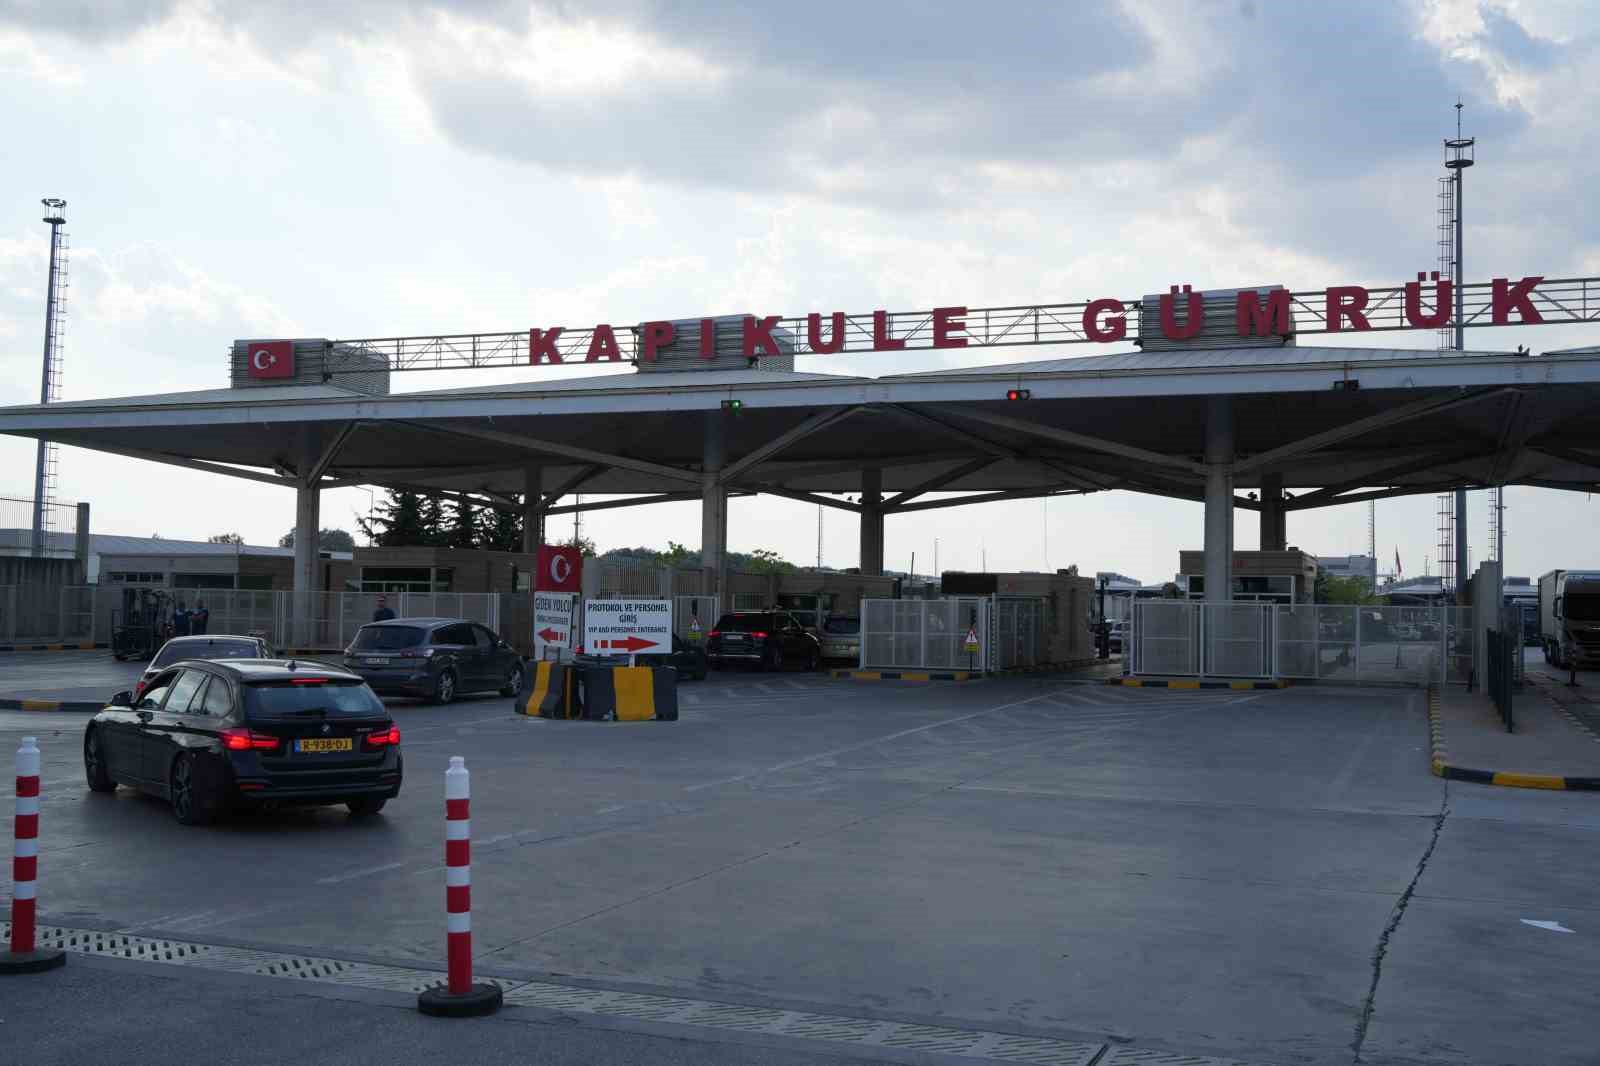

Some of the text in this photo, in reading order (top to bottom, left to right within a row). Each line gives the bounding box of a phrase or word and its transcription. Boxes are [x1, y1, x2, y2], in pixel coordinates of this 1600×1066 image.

[529, 271, 1545, 366] KAPIKULE GÜMRÜK
[588, 603, 668, 612] PROTOKOL VE PERSONEL
